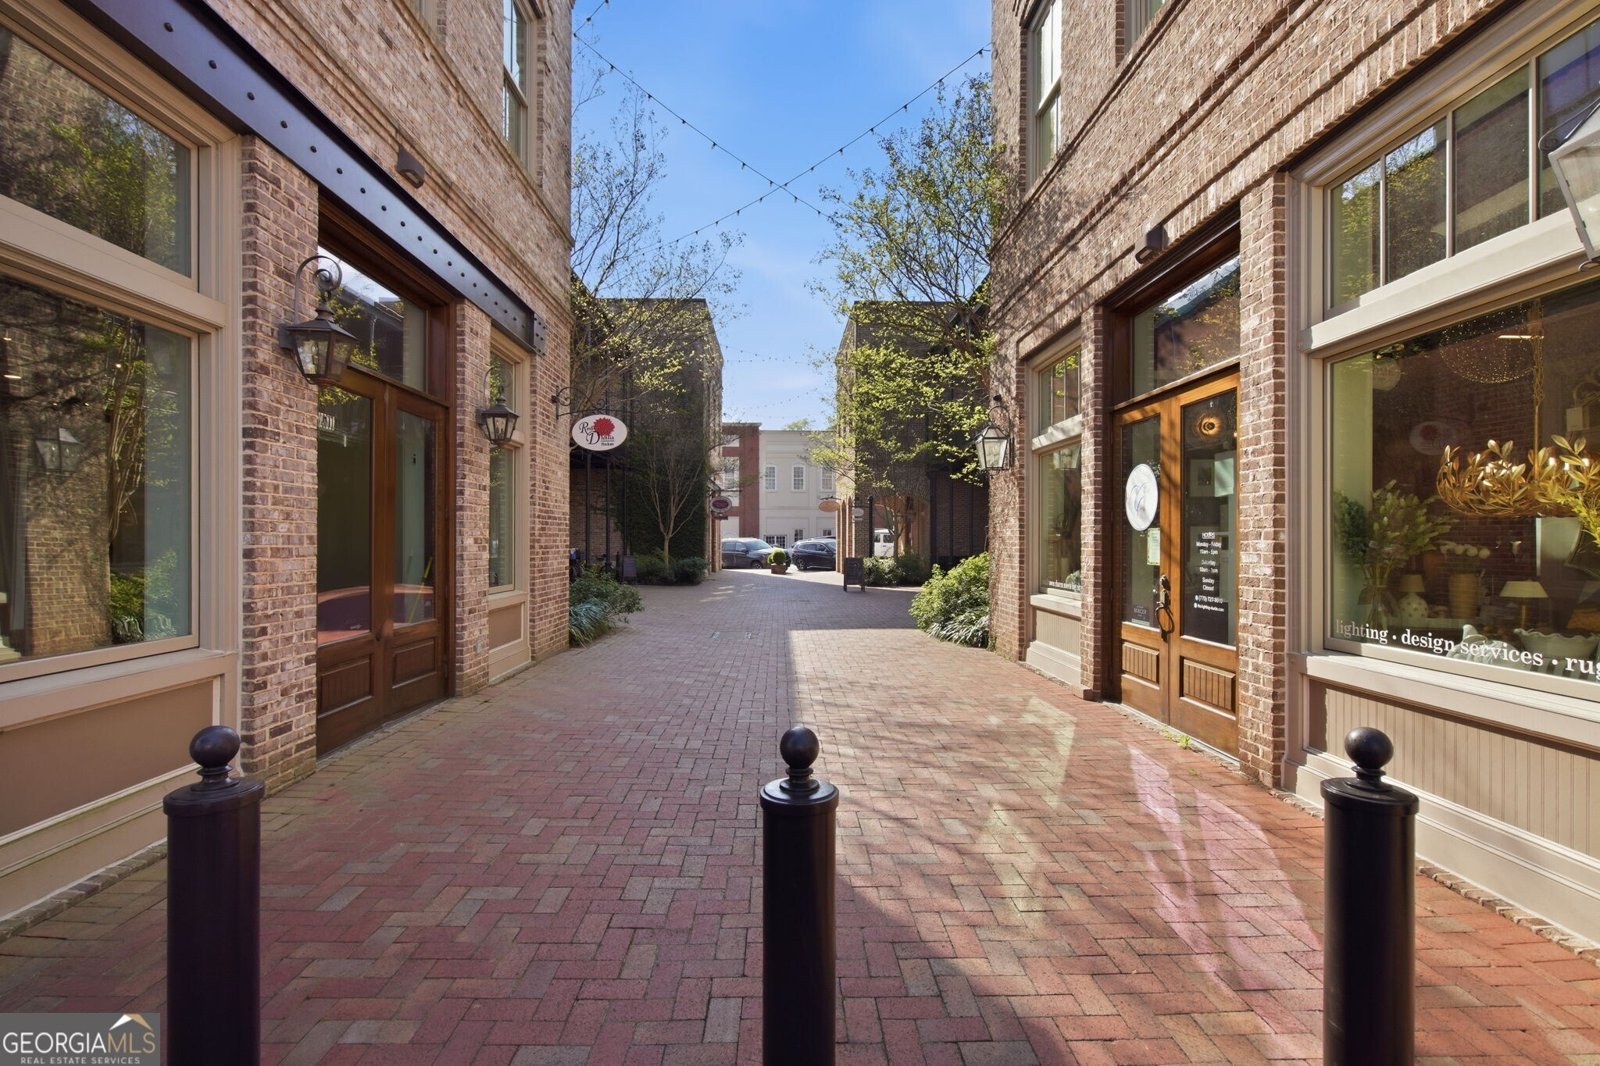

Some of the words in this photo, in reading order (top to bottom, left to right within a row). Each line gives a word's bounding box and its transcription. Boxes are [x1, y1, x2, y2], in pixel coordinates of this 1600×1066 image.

[1336, 620, 1388, 645] lighting
[1401, 628, 1455, 654] design
[1460, 641, 1544, 666] services
